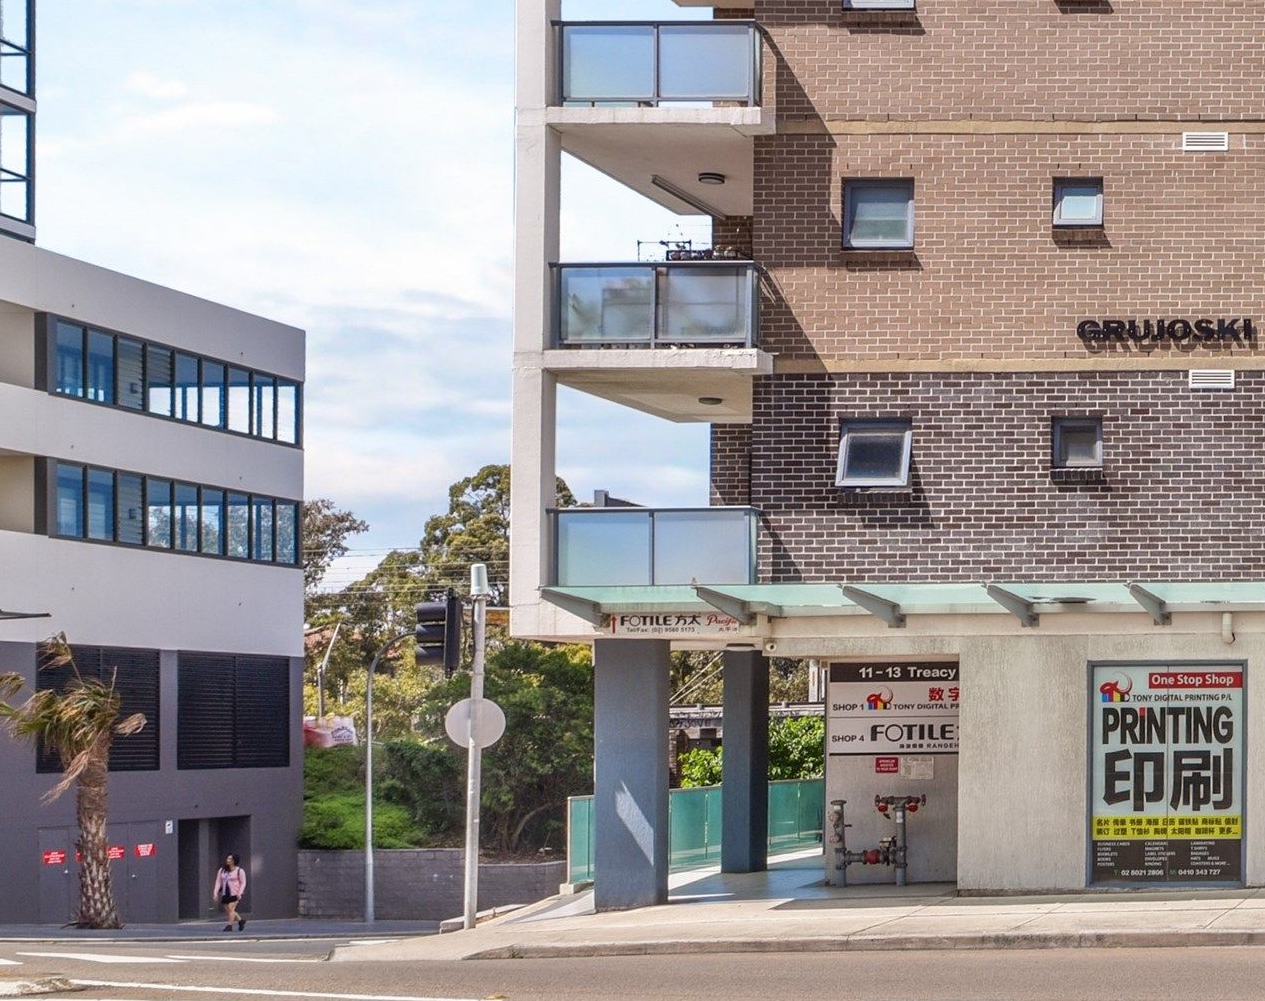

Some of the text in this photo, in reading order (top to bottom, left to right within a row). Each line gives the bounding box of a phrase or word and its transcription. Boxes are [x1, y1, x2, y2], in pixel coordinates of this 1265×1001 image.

[1076, 318, 1253, 342] GRUJOSKI
[620, 614, 701, 627] FOTILE 方太
[907, 666, 957, 680] Treacy
[1151, 673, 1234, 688] One Stop Shop
[1184, 694, 1219, 702] PRINTING
[832, 703, 864, 711] SHOP 1
[858, 734, 865, 742] 4
[870, 724, 954, 742] FOTILE
[1102, 747, 1233, 812] 印刷
